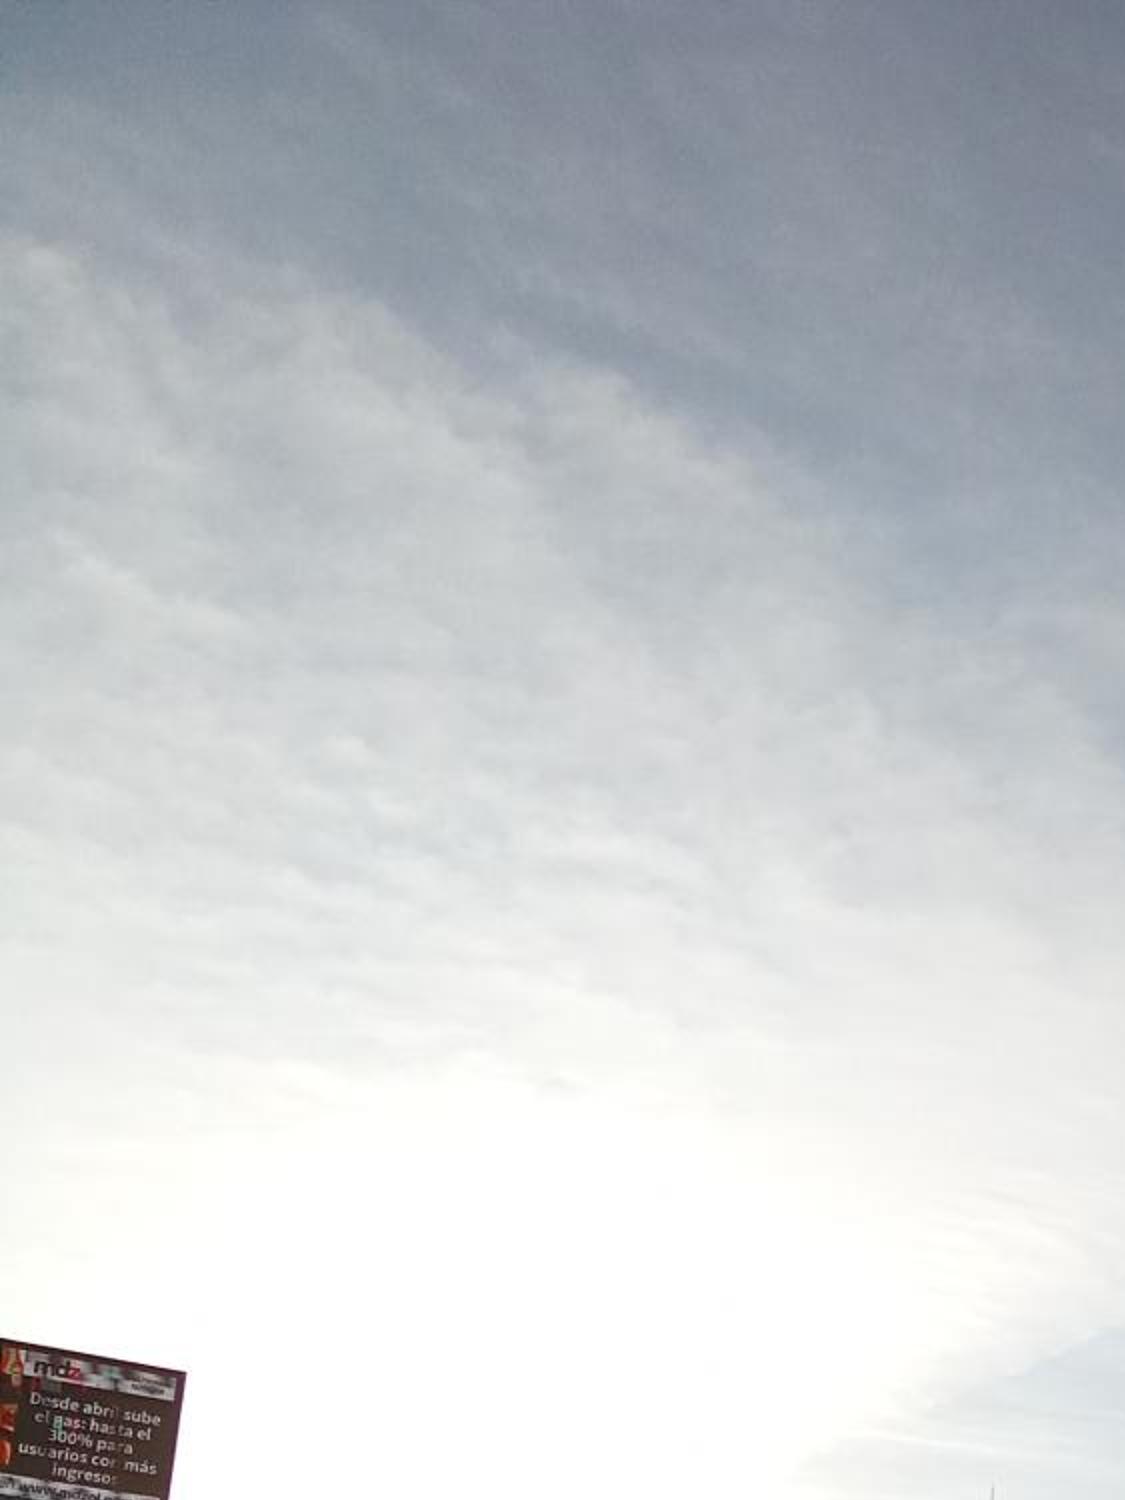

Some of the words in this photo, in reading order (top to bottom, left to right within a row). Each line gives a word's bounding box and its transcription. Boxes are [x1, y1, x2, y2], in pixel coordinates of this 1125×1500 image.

[31, 1392, 80, 1412] Desde
[124, 1410, 161, 1427] sube
[35, 1410, 50, 1425] el
[89, 1417, 133, 1439] hasta
[137, 1426, 151, 1441] el
[48, 1426, 93, 1449] 300%
[96, 1439, 133, 1455] para
[19, 1441, 88, 1464] usuarios
[124, 1458, 158, 1476] más
